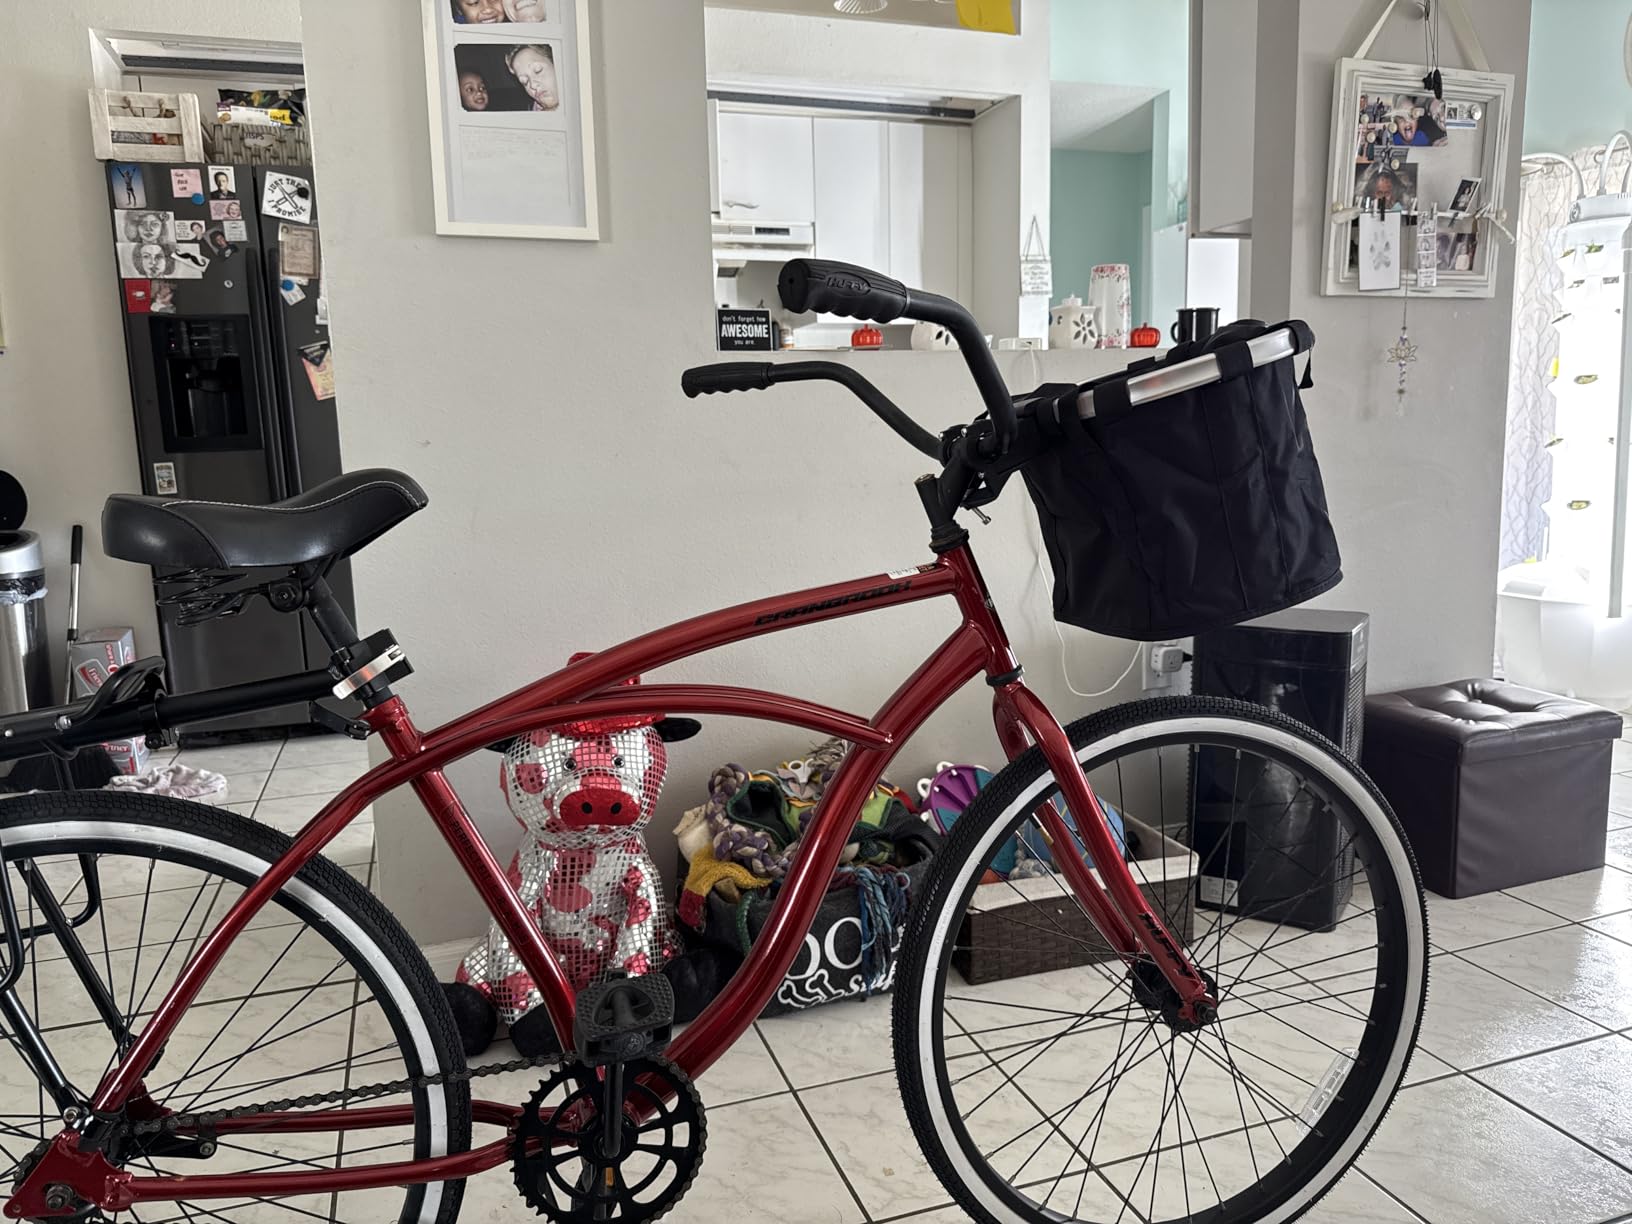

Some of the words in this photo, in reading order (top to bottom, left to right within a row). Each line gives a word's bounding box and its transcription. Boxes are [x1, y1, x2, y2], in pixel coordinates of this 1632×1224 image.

[268, 178, 284, 194] JUST
[271, 205, 307, 217] PROMISE
[826, 277, 868, 292] HUFFY
[721, 323, 769, 338] AWESOME
[1137, 912, 1193, 977] HUFFY
